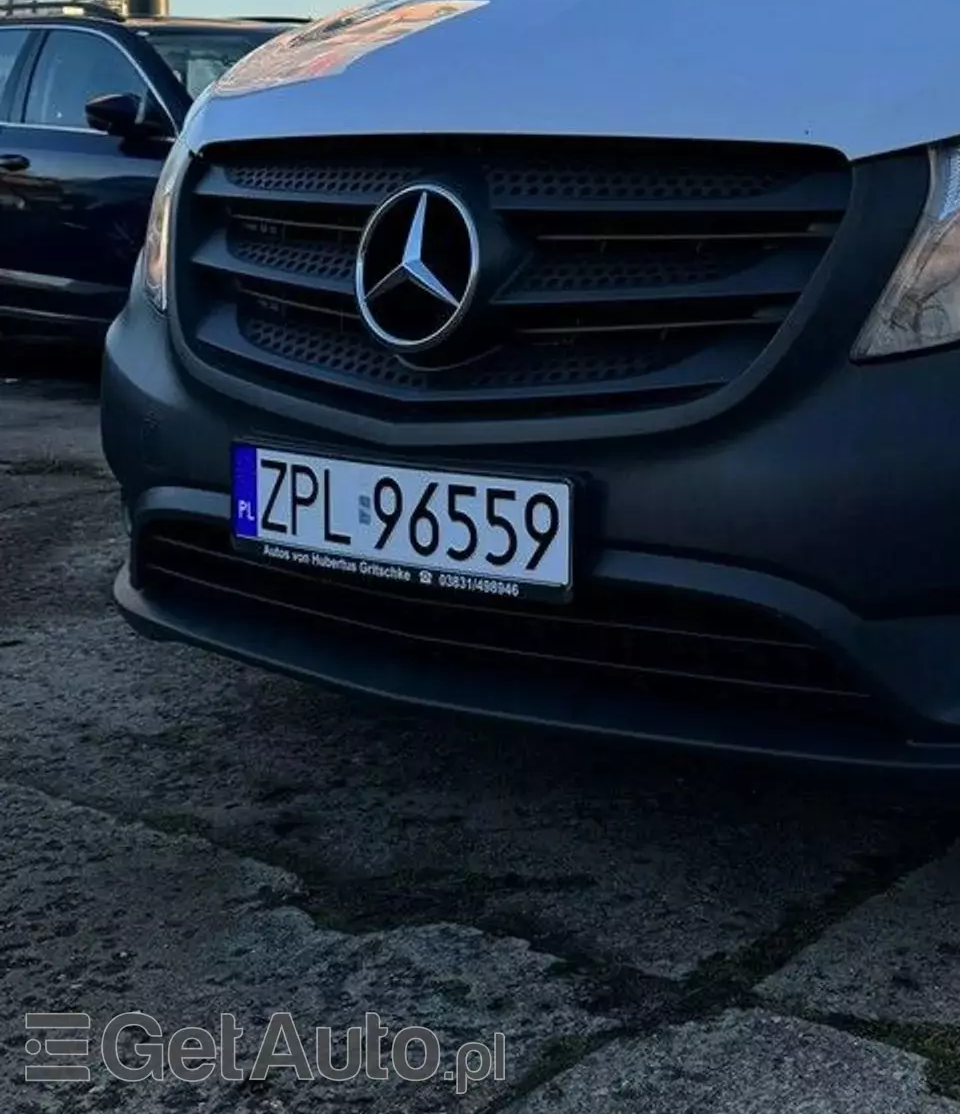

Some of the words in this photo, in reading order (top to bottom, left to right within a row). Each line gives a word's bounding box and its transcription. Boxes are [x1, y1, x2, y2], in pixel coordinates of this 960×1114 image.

[238, 499, 256, 520] PL
[260, 459, 351, 545] ZPL
[373, 476, 559, 570] 96559
[263, 544, 290, 560] Autos
[292, 552, 308, 564] von
[311, 554, 357, 572] Hubertus
[359, 561, 411, 581] Gritschke
